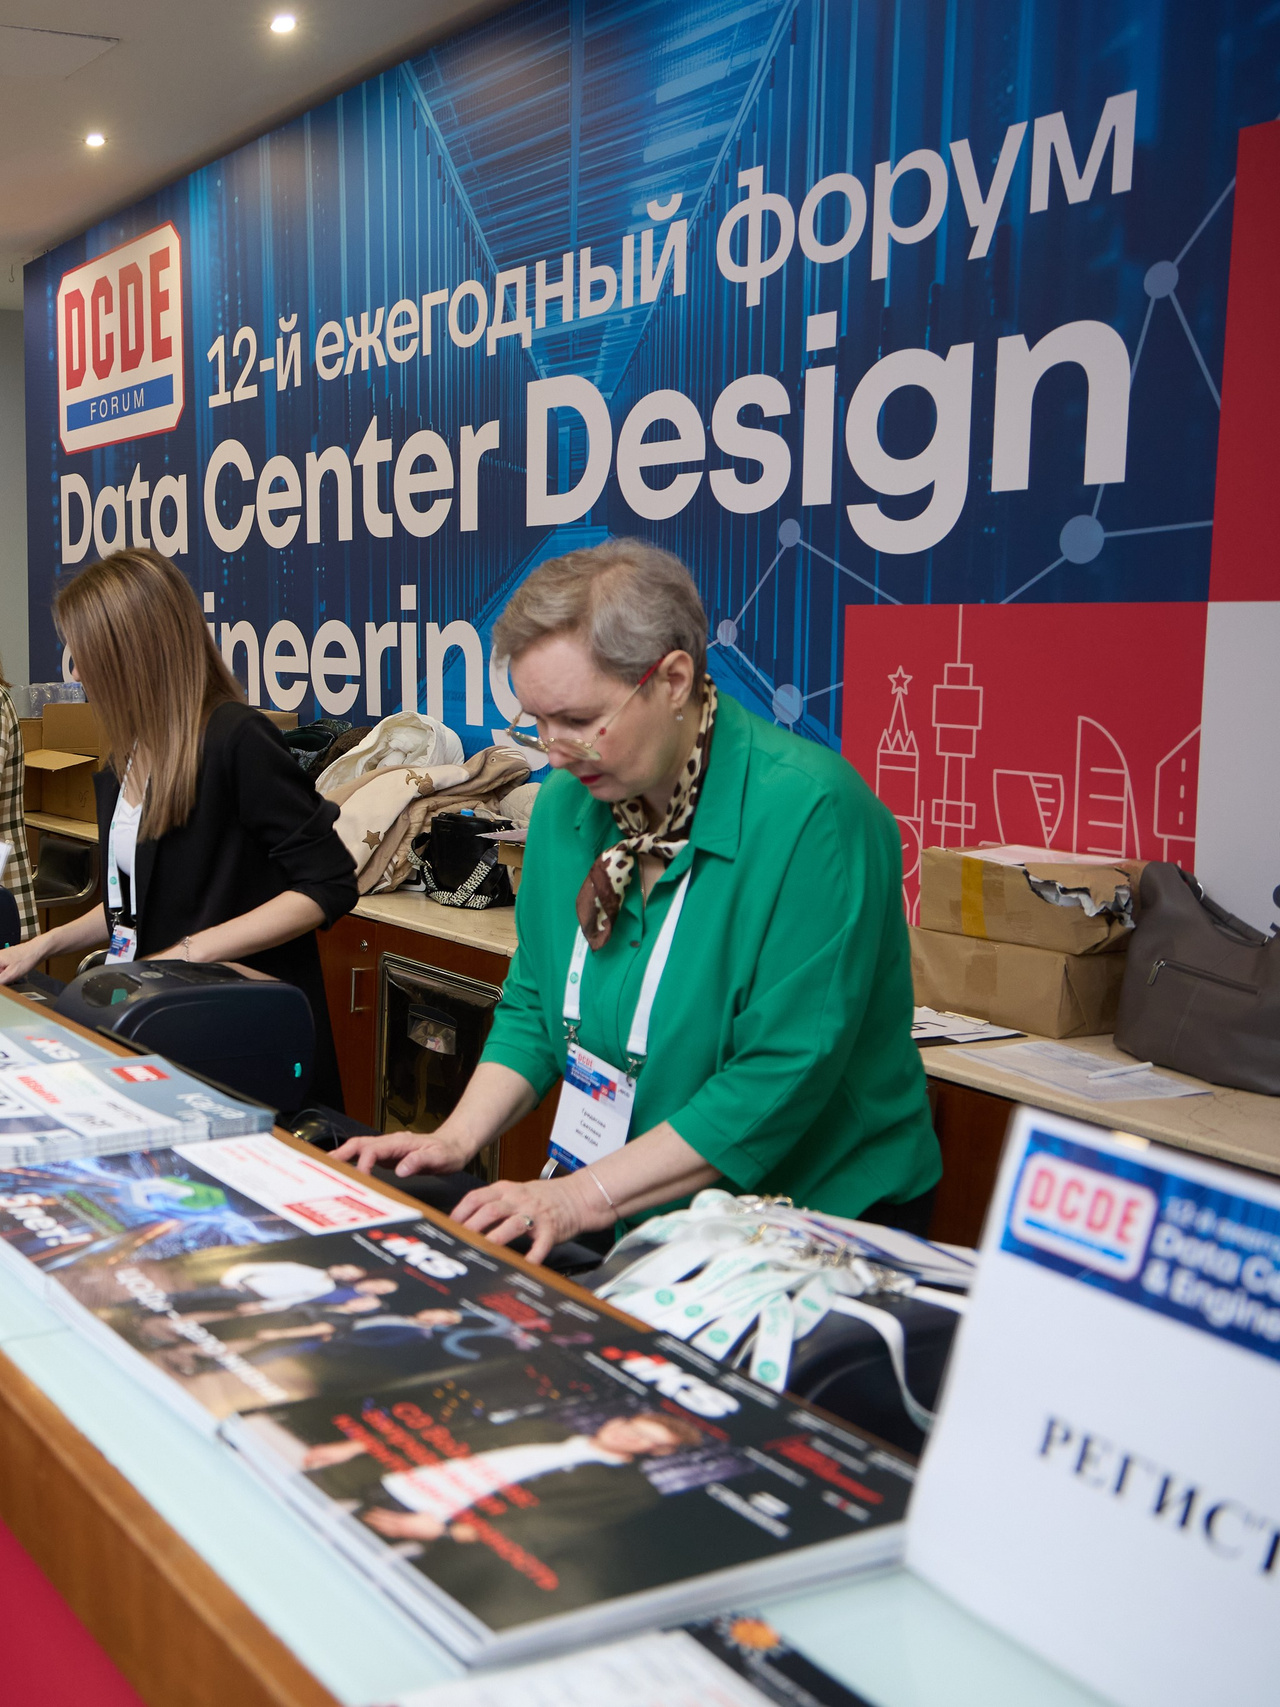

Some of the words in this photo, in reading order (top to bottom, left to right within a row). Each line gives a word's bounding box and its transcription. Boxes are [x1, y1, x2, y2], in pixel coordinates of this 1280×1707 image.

[64, 246, 173, 391] DCDE
[207, 313, 302, 409] 12-й
[315, 193, 688, 381] ежегодный
[716, 89, 1138, 308] форум
[60, 462, 188, 564] Data
[203, 415, 500, 553] Center
[525, 310, 1132, 555] Design
[90, 387, 145, 421] FORUM
[1027, 1167, 1142, 1246] DCDE
